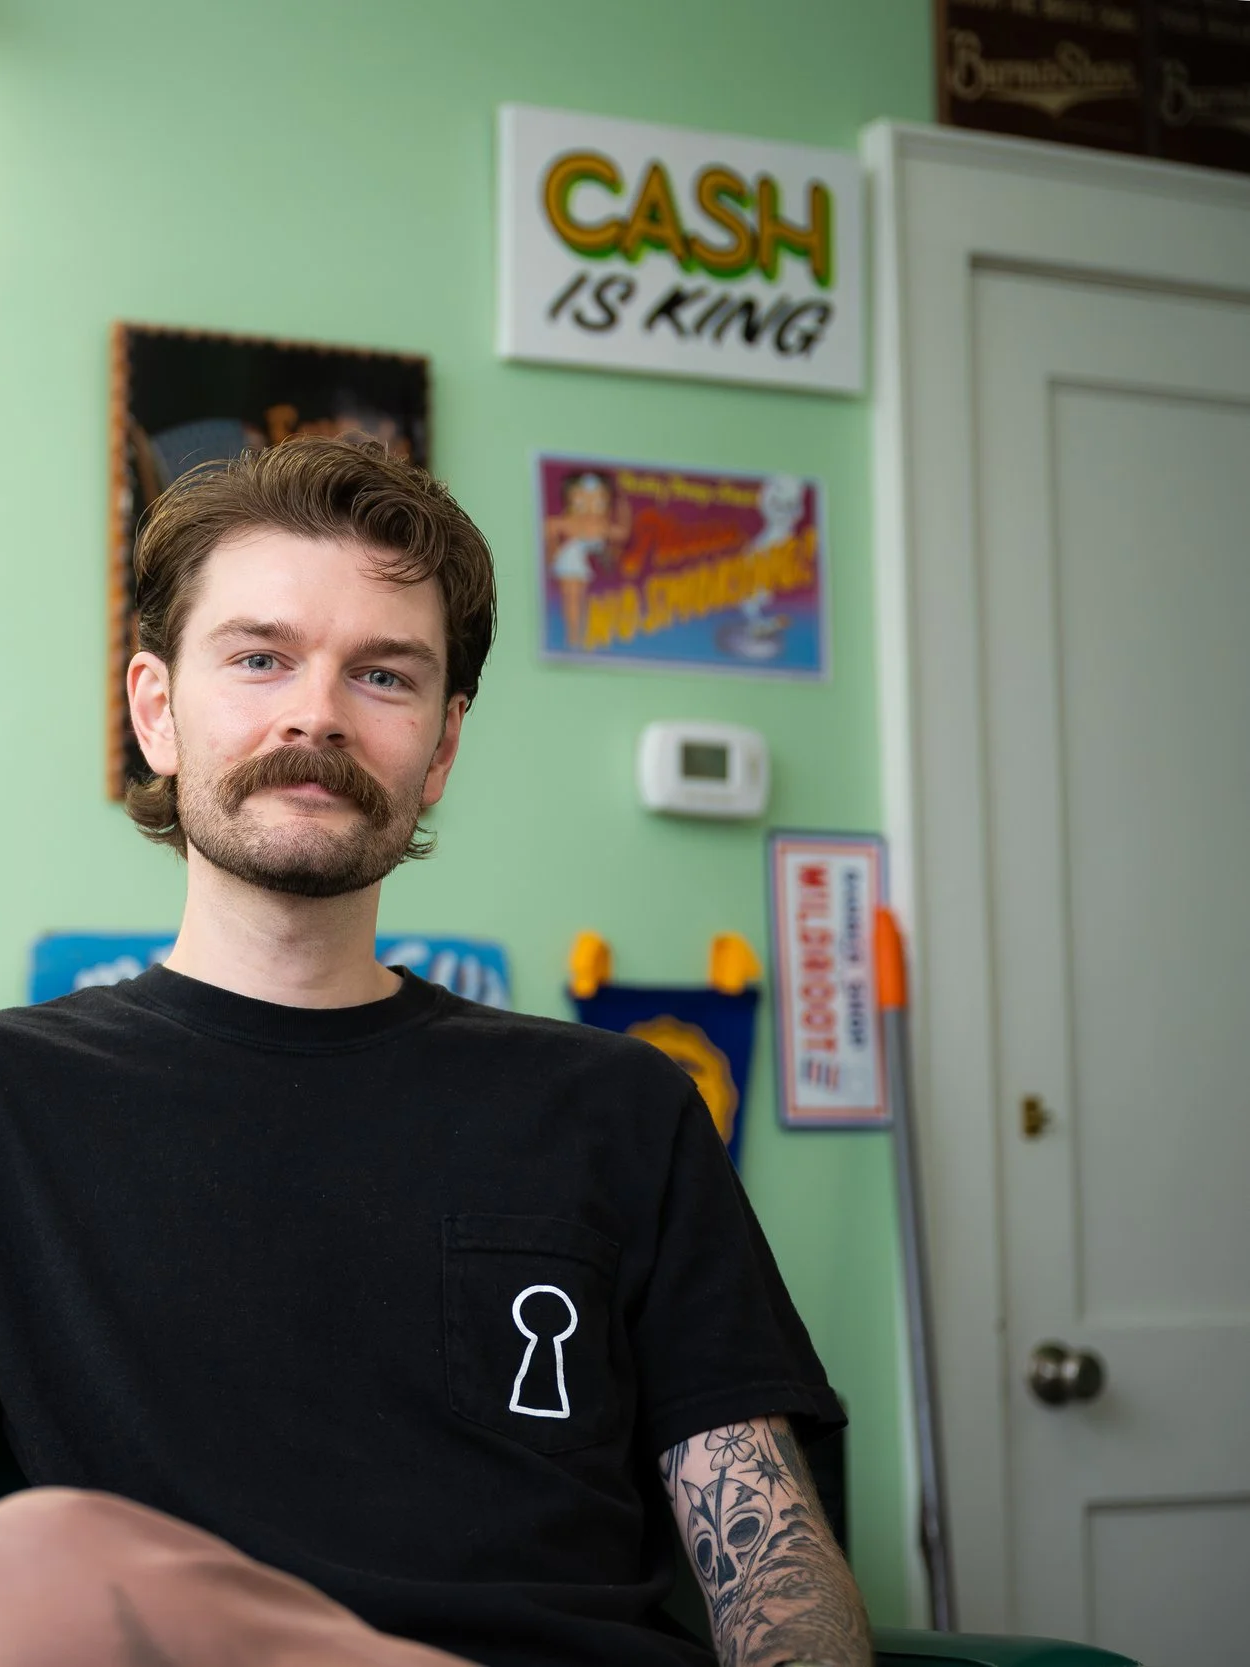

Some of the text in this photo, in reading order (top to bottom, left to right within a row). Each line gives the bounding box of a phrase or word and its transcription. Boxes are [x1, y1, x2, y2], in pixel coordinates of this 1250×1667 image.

[542, 149, 833, 290] CASH
[548, 272, 833, 357] IS KING
